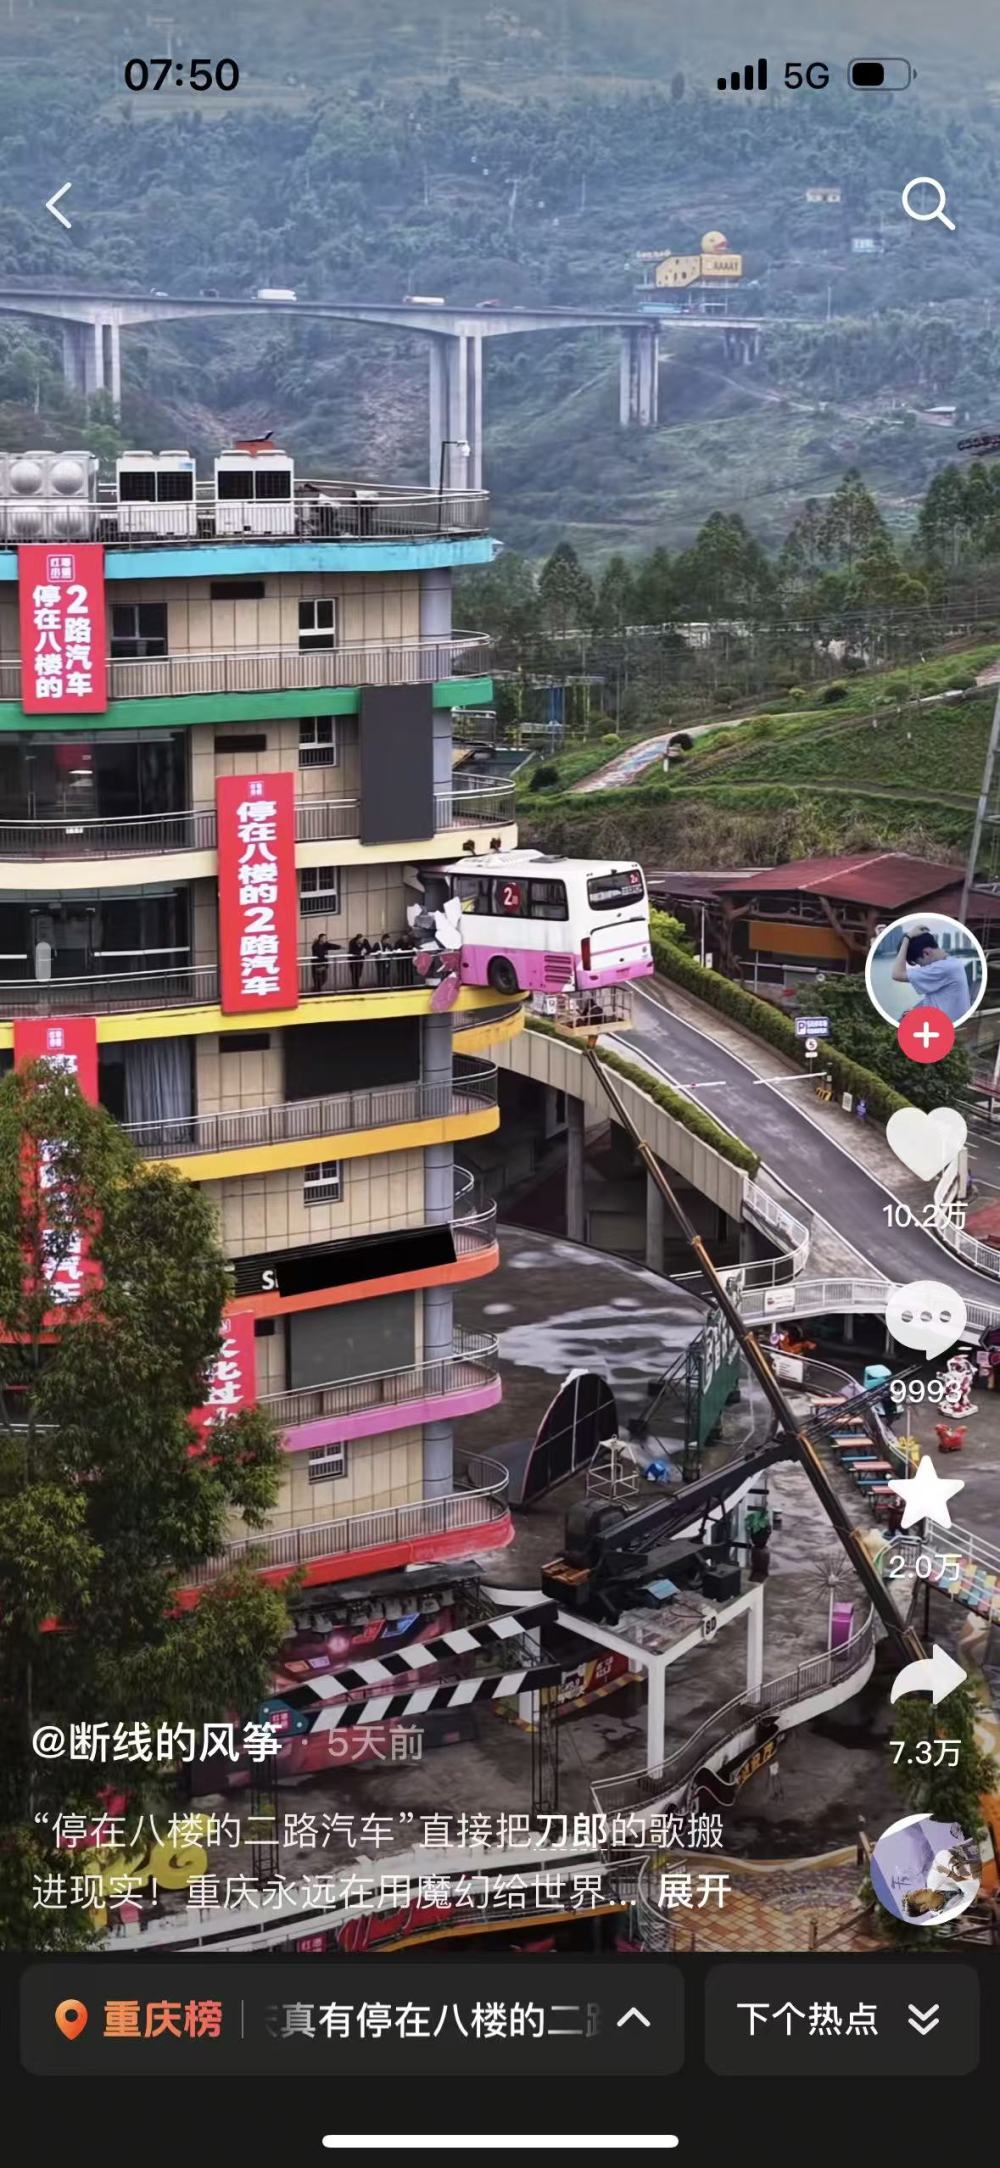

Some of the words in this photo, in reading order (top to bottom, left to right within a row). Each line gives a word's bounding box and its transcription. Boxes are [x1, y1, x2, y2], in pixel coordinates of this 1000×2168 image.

[32, 584, 63, 699] 停在八楼的
[64, 584, 93, 697] 2路汽车
[236, 800, 280, 996] 停在八楼的2路汽车
